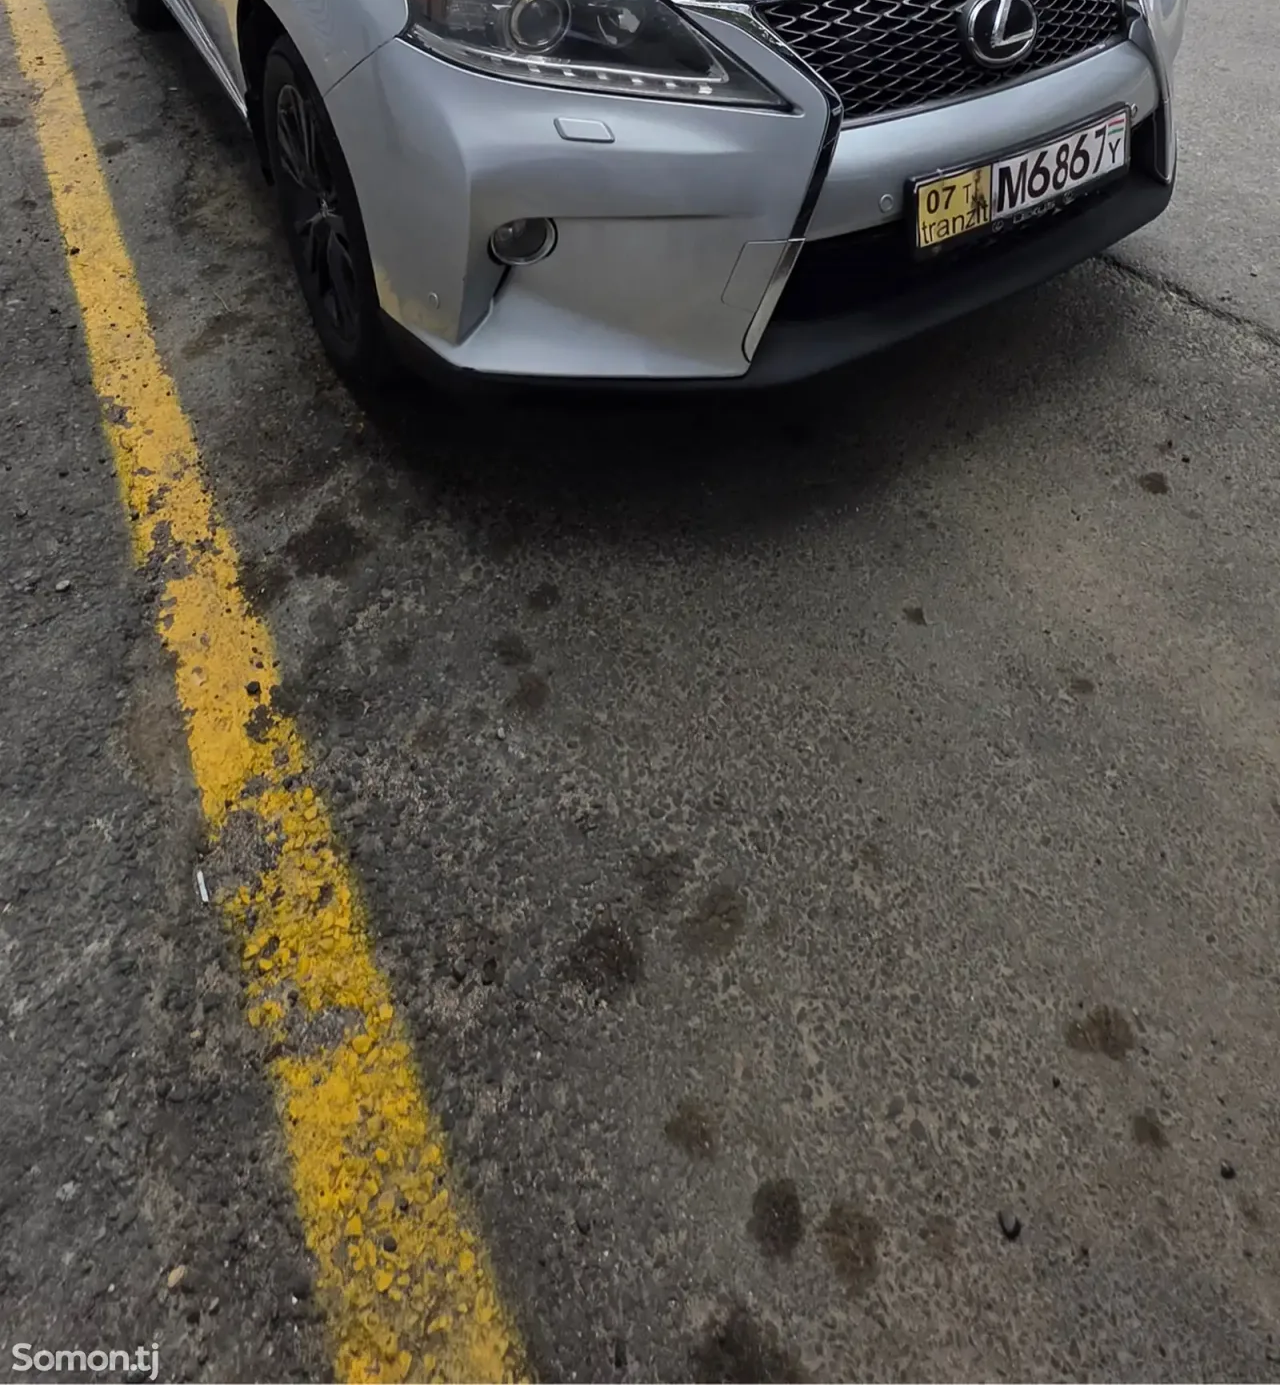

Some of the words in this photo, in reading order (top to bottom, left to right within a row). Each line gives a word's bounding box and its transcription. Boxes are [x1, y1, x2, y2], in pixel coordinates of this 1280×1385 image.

[997, 124, 1107, 212] M6867
[1108, 138, 1121, 164] Y
[926, 185, 957, 214] 07
[922, 200, 989, 245] tranzit
